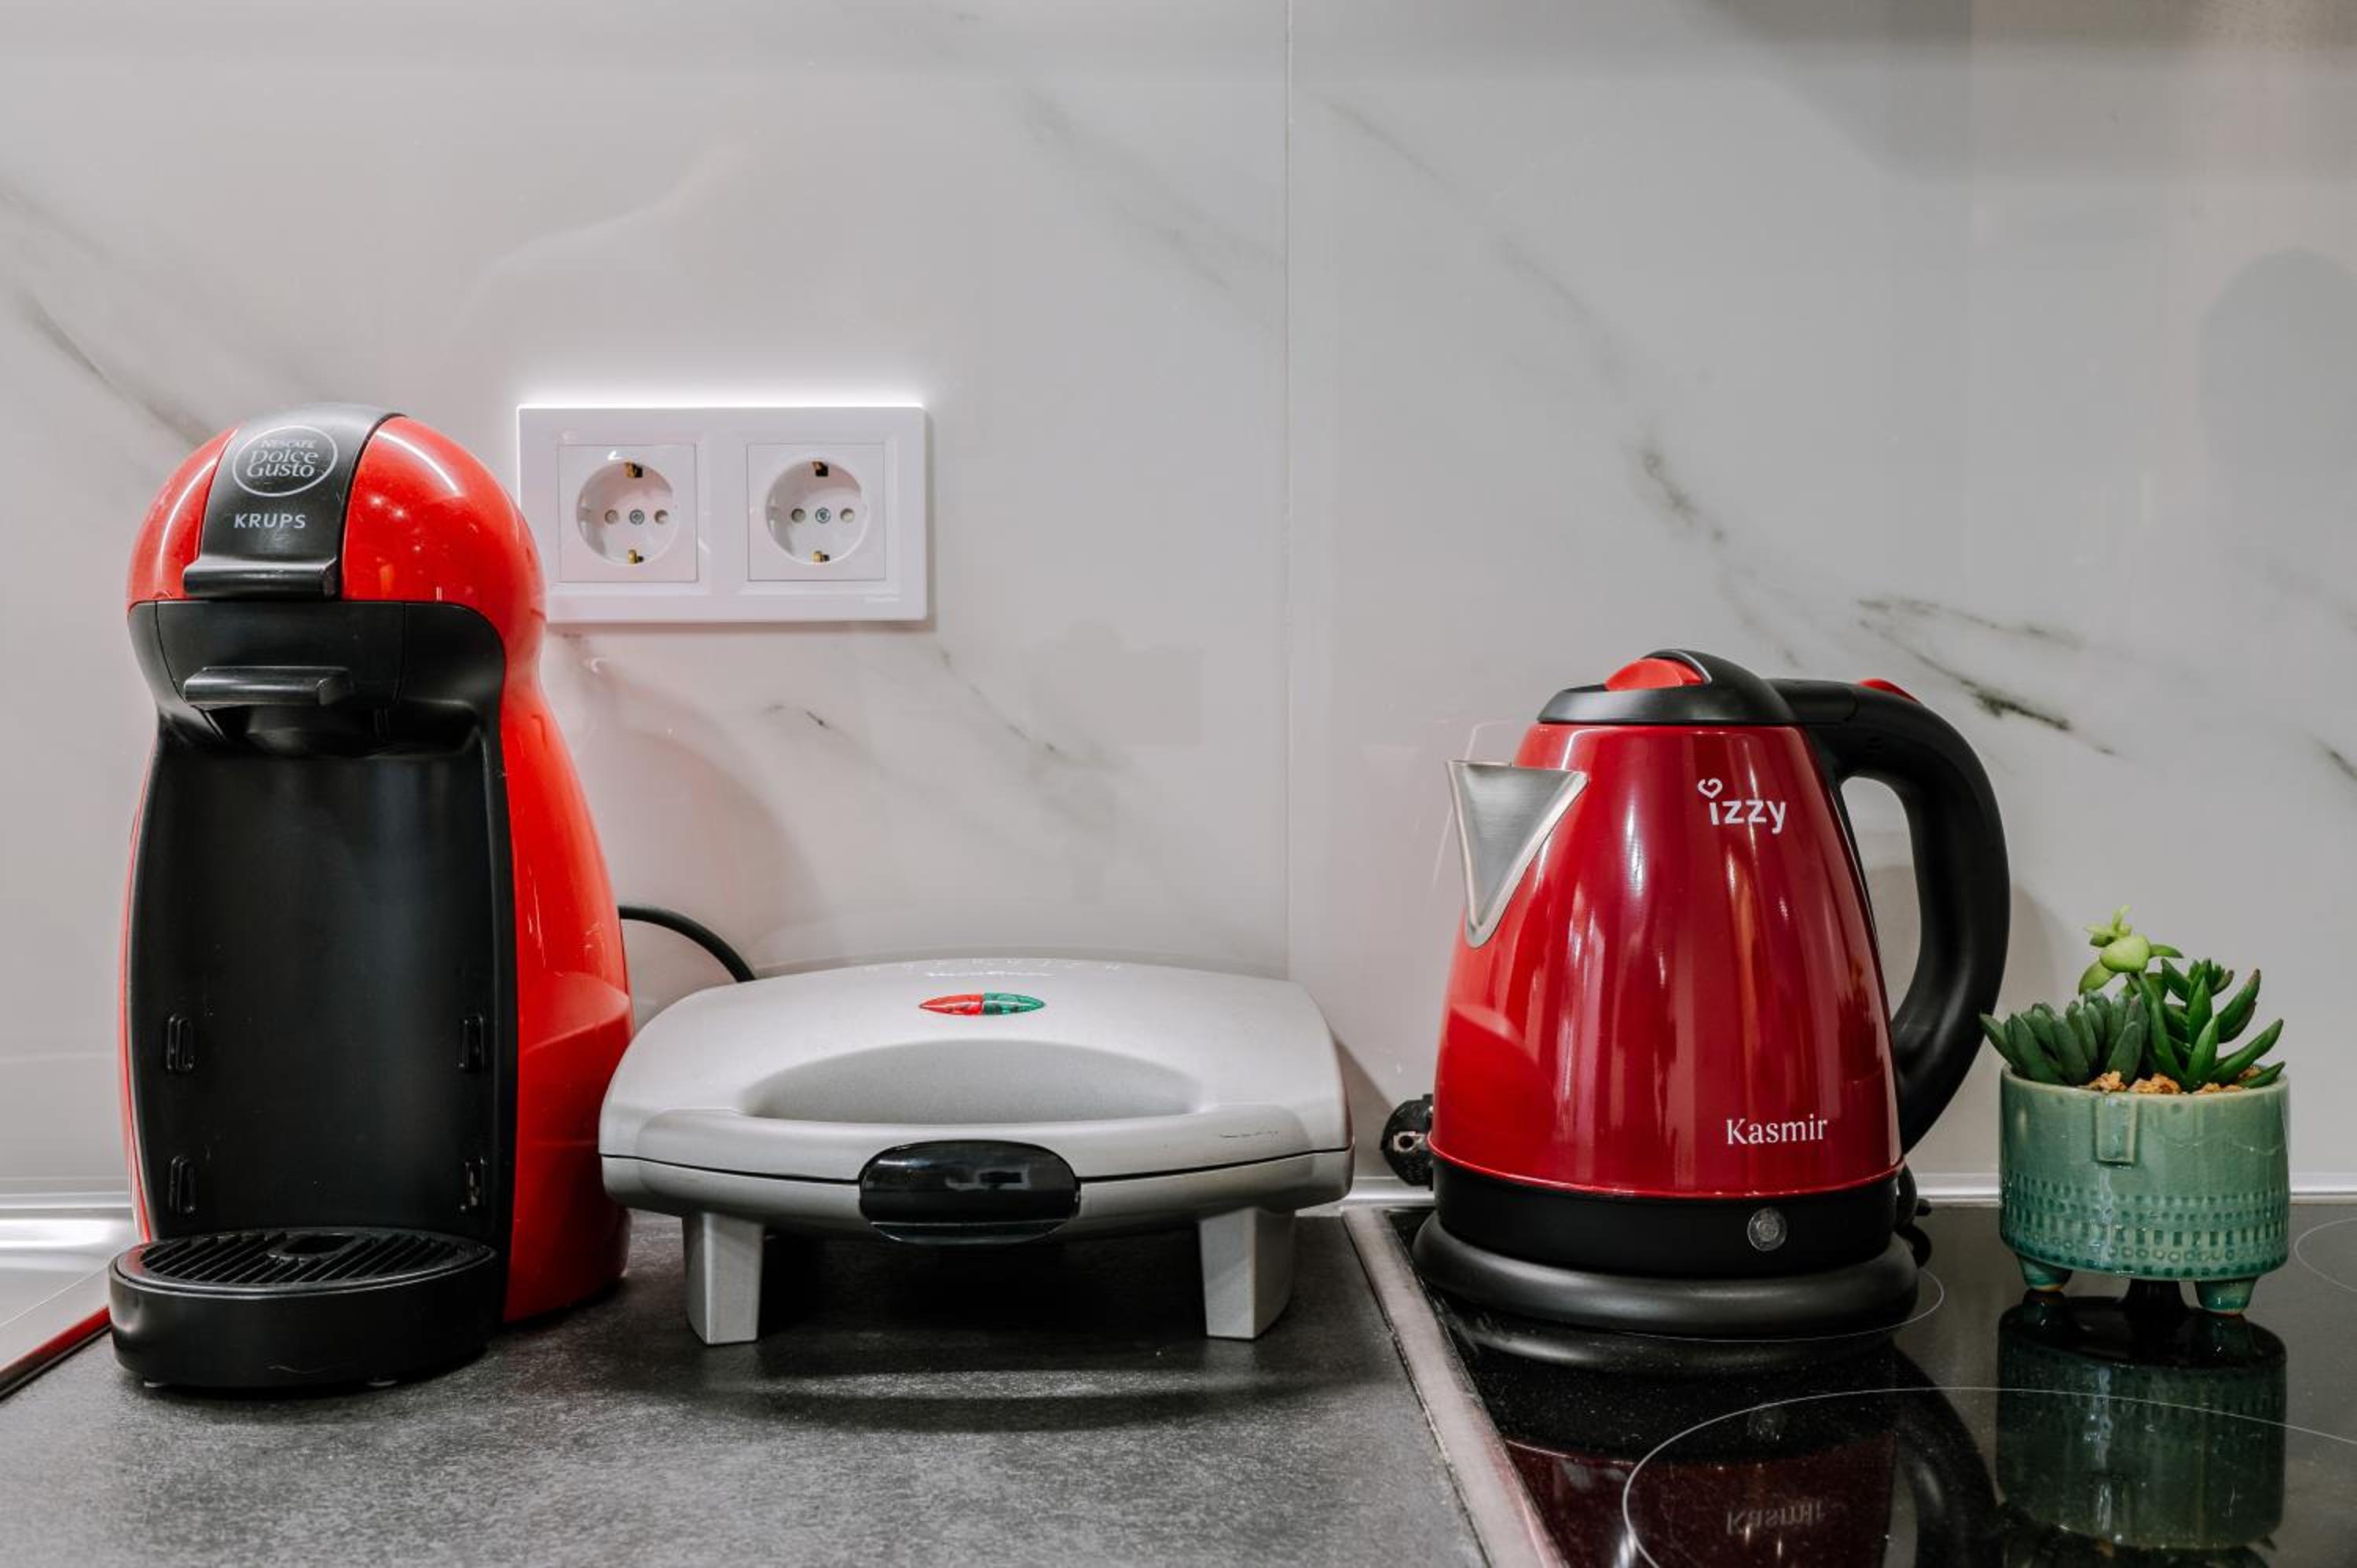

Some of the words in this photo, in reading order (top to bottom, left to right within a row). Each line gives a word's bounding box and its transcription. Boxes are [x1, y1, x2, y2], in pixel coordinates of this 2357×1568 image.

[250, 449, 319, 464] Dolce
[246, 462, 315, 478] Gusto
[233, 513, 306, 529] KRUPS
[1697, 778, 1787, 834] izzy
[1725, 1113, 1828, 1145] Kasmir
